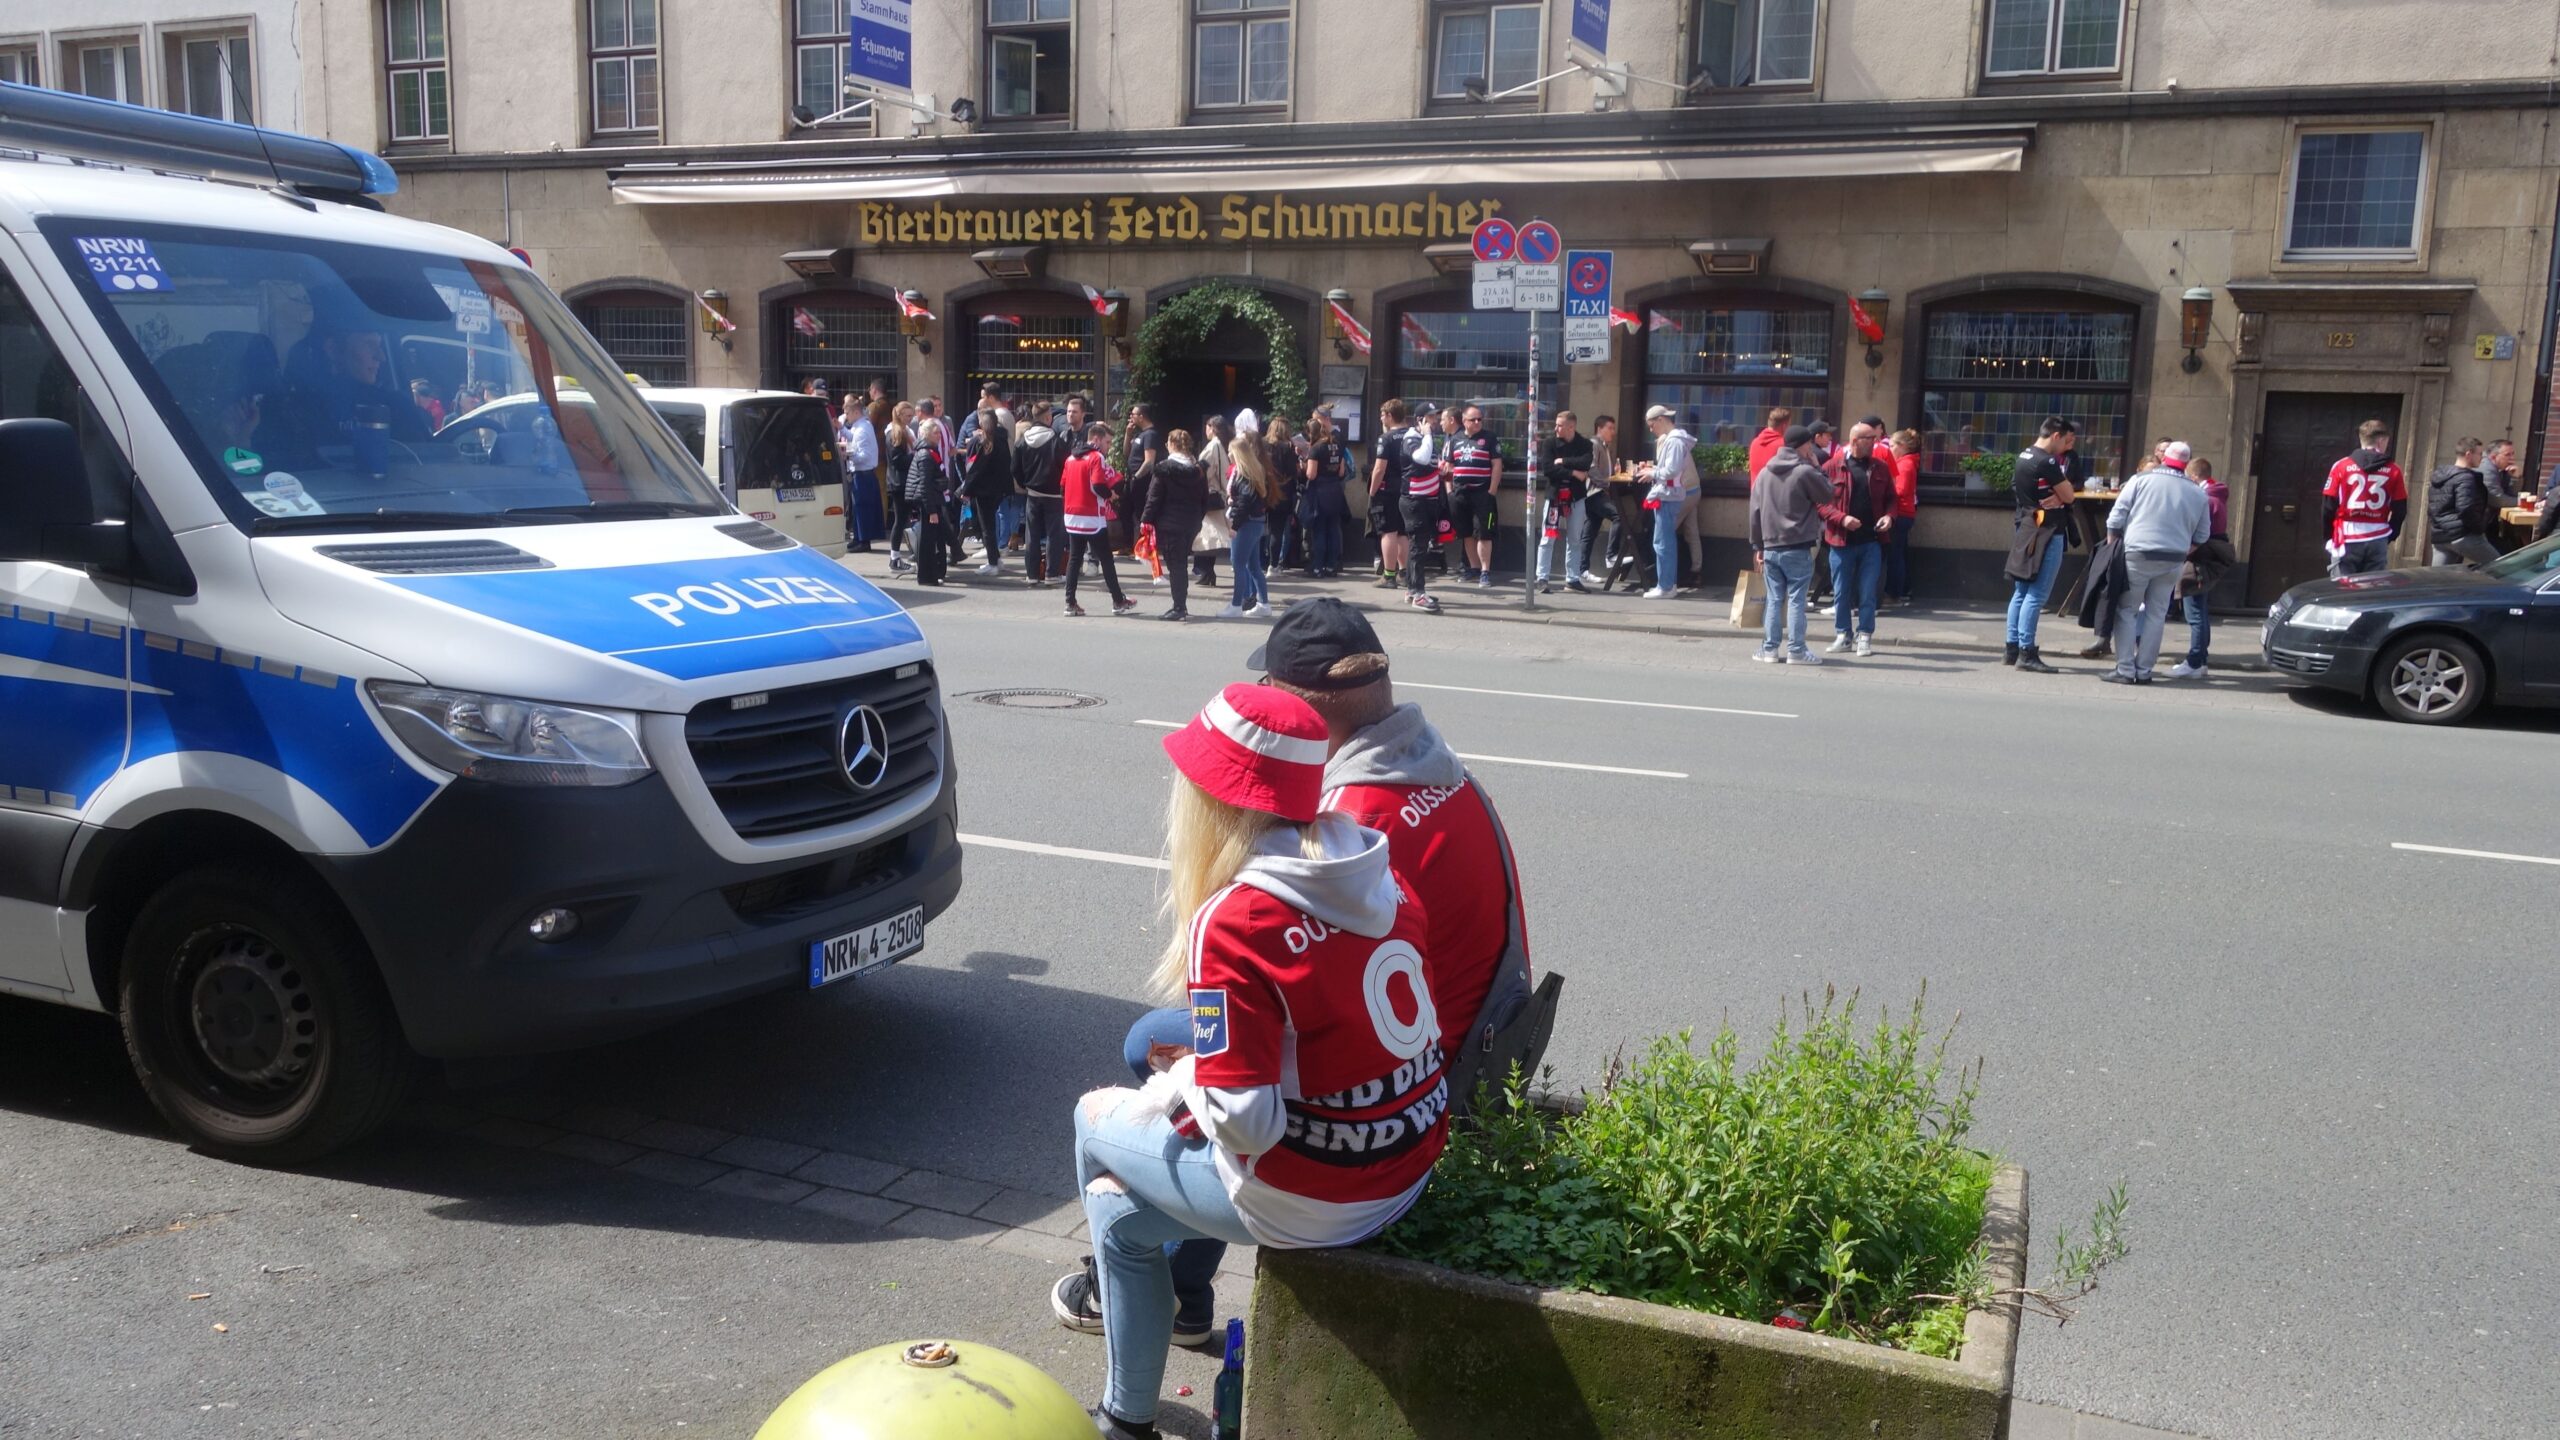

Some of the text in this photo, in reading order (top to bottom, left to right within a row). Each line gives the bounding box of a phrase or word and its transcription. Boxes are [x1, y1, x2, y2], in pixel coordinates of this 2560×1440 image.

[860, 0, 908, 24] Stammhaus
[860, 37, 905, 62] Schumacher
[858, 191, 1501, 243] Bierbrauerei Ferd. Schumacher
[77, 238, 146, 254] NRW
[89, 256, 161, 272] 31211
[1520, 292, 1526, 303] 6
[1535, 292, 1545, 303] 18
[1547, 292, 1553, 303] h
[1569, 300, 1606, 315] TAXI
[2328, 332, 2354, 347] 123
[2346, 473, 2389, 510] 23
[630, 577, 858, 627] POLIZEI
[824, 909, 922, 977] NRW 4-2508
[1193, 1006, 1220, 1017] ETRO
[1195, 1022, 1218, 1043] hef
